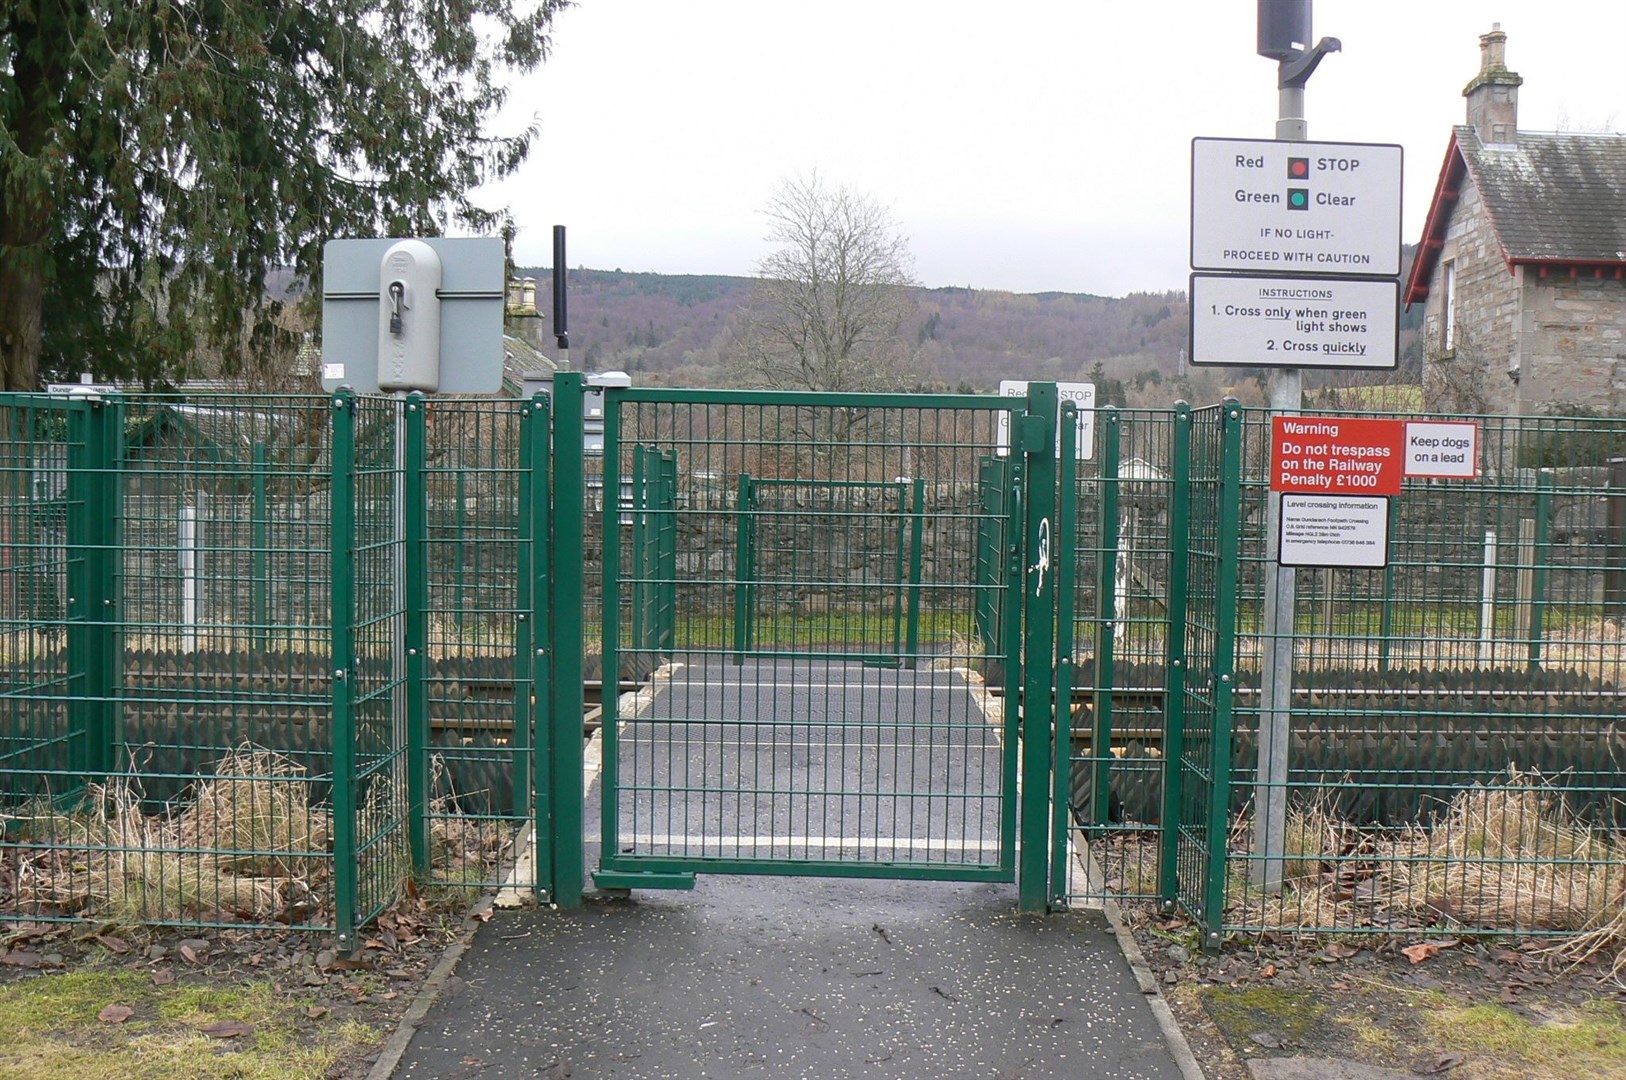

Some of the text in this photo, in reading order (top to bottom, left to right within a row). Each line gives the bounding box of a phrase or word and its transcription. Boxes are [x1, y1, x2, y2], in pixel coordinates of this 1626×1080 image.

[1236, 155, 1359, 171] Red STOP
[1235, 190, 1355, 205] Green Clear
[1261, 229, 1271, 237] IF
[1275, 229, 1292, 238] NO
[1224, 250, 1369, 263] PROCEED WITH CAUTION
[1260, 289, 1332, 299] INSTRUCTIONS
[1212, 305, 1366, 320] 1. Cross only when green
[1297, 321, 1366, 333] light shows
[1267, 340, 1366, 354] 2. Cross quickly
[1060, 390, 1092, 401] STOP
[1283, 423, 1338, 437] Warning
[1411, 437, 1469, 449] Keep dogs
[1283, 443, 1391, 459] Do not trespass
[1441, 453, 1464, 463] lead
[1282, 459, 1382, 474] on the Railway
[1282, 473, 1378, 488] Penalty £1000
[1307, 502, 1338, 510] crossing
[1338, 502, 1379, 510] information
